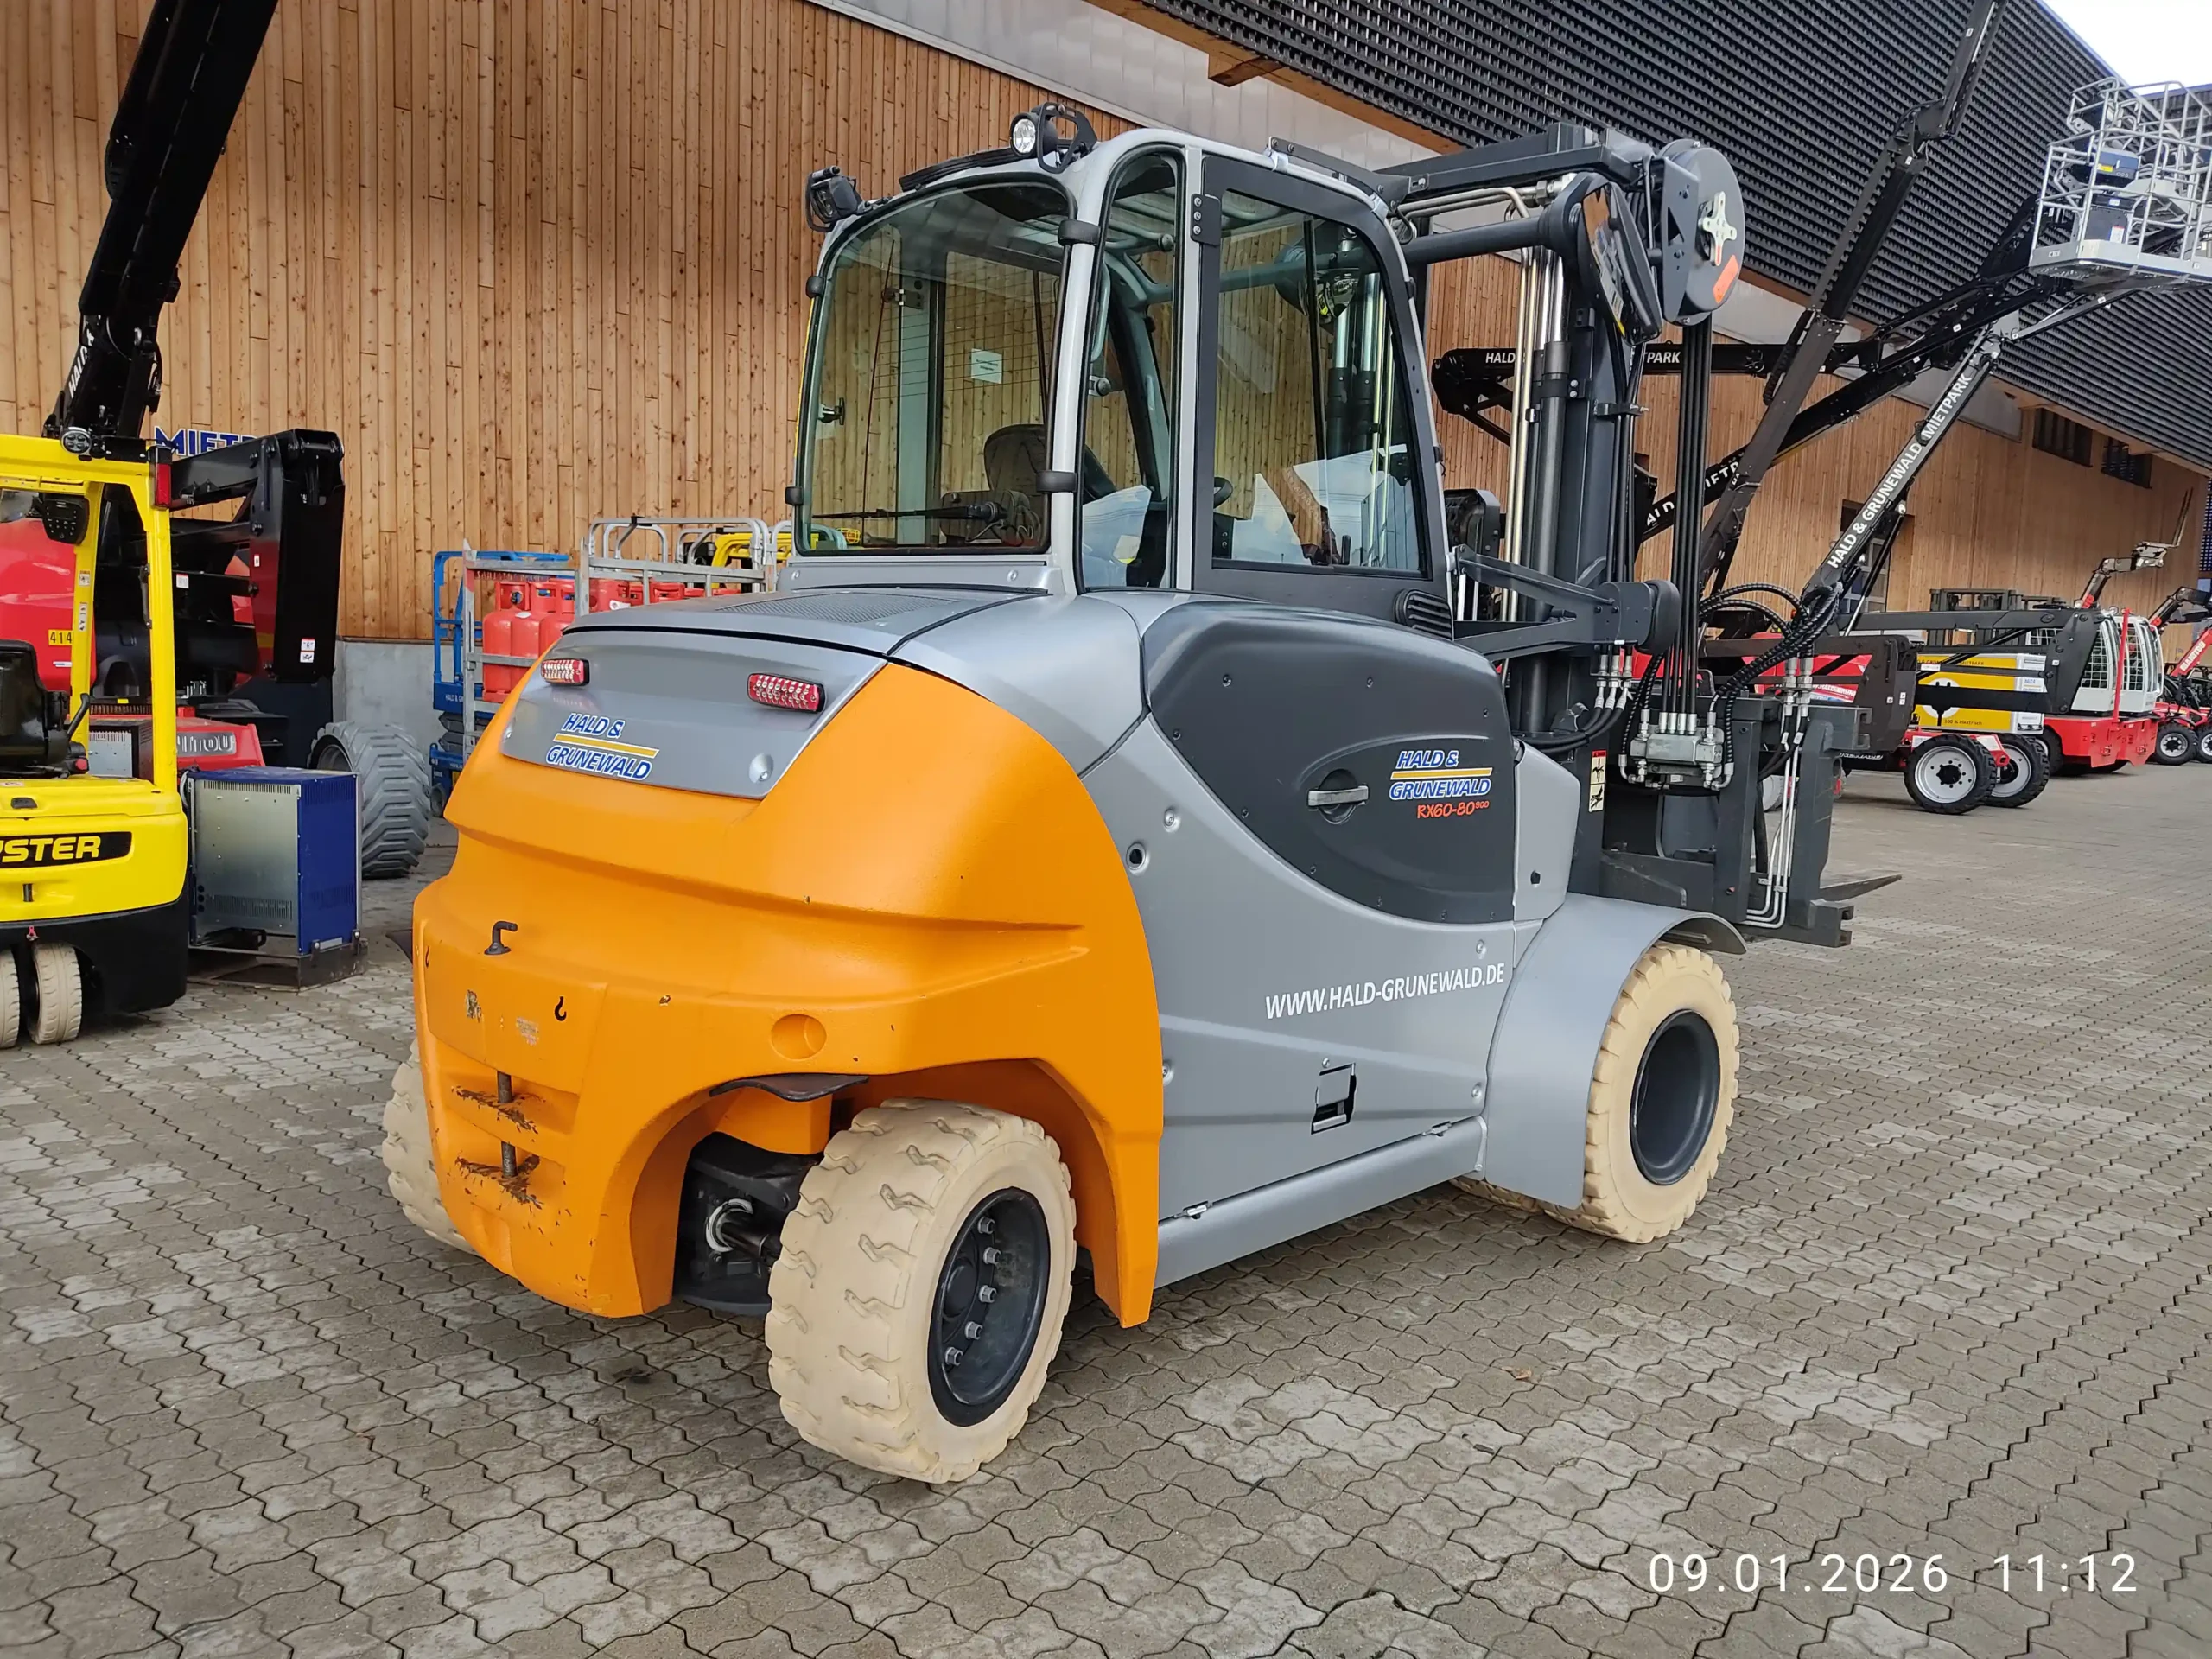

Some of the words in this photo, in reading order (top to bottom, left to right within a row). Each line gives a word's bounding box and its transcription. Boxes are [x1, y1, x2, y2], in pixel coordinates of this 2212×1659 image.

[1485, 352, 1516, 364] HALD
[1643, 351, 1681, 364] PARK
[155, 426, 258, 457] MIET
[1827, 534, 1858, 569] HALD
[1853, 522, 1867, 535] &
[1862, 442, 1923, 522] GRUNEWALD
[1921, 373, 1972, 441] MIETPARK
[49, 632, 73, 644] 414
[562, 713, 609, 735] HALD
[607, 720, 625, 739] &
[546, 745, 652, 781] GRUNEWALD
[1395, 750, 1446, 769] HALD
[1445, 750, 1459, 767] &
[1389, 778, 1491, 800] GRUNEWALD
[0, 836, 101, 863] STER
[1266, 963, 1505, 1020] WWW.HALD-GRUNEWALD.DE
